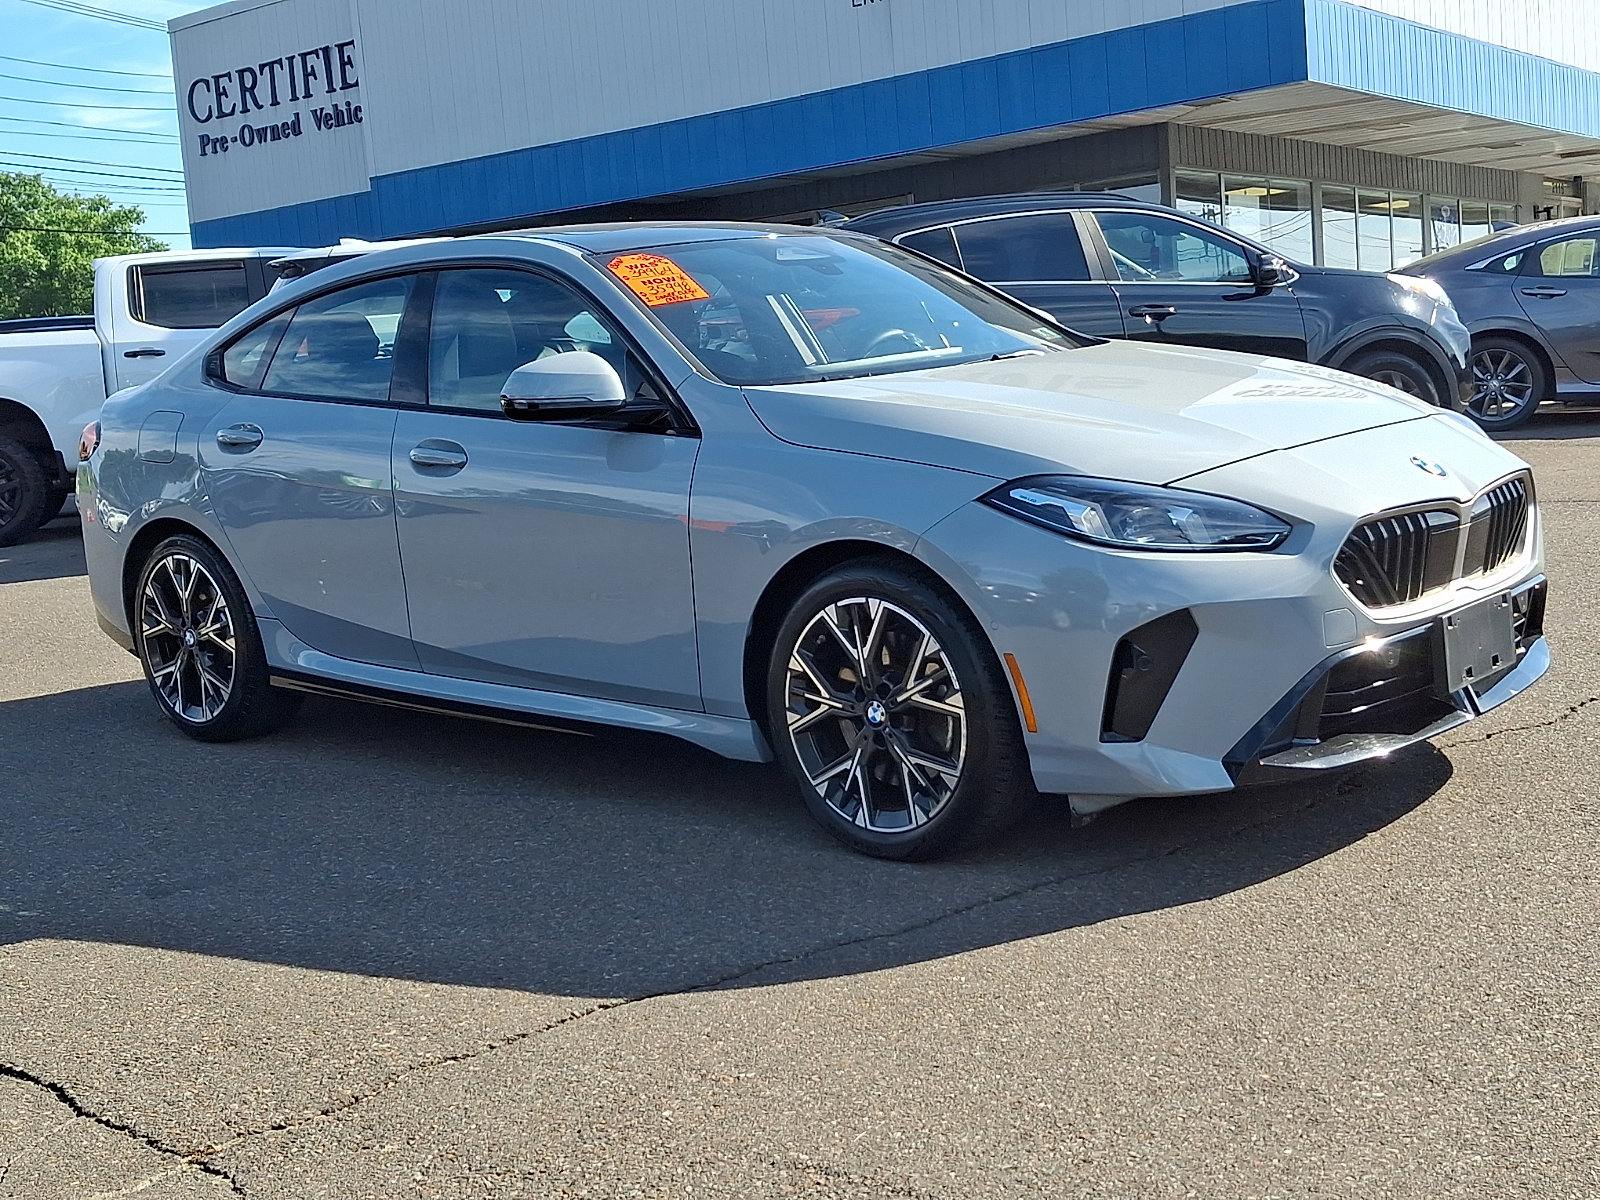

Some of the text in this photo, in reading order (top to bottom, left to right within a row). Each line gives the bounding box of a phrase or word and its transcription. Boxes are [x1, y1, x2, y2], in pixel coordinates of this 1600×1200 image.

[187, 39, 360, 124] CERTIFIE
[198, 100, 364, 157] Pre-Owned Vehic
[640, 275, 676, 286] NOW
